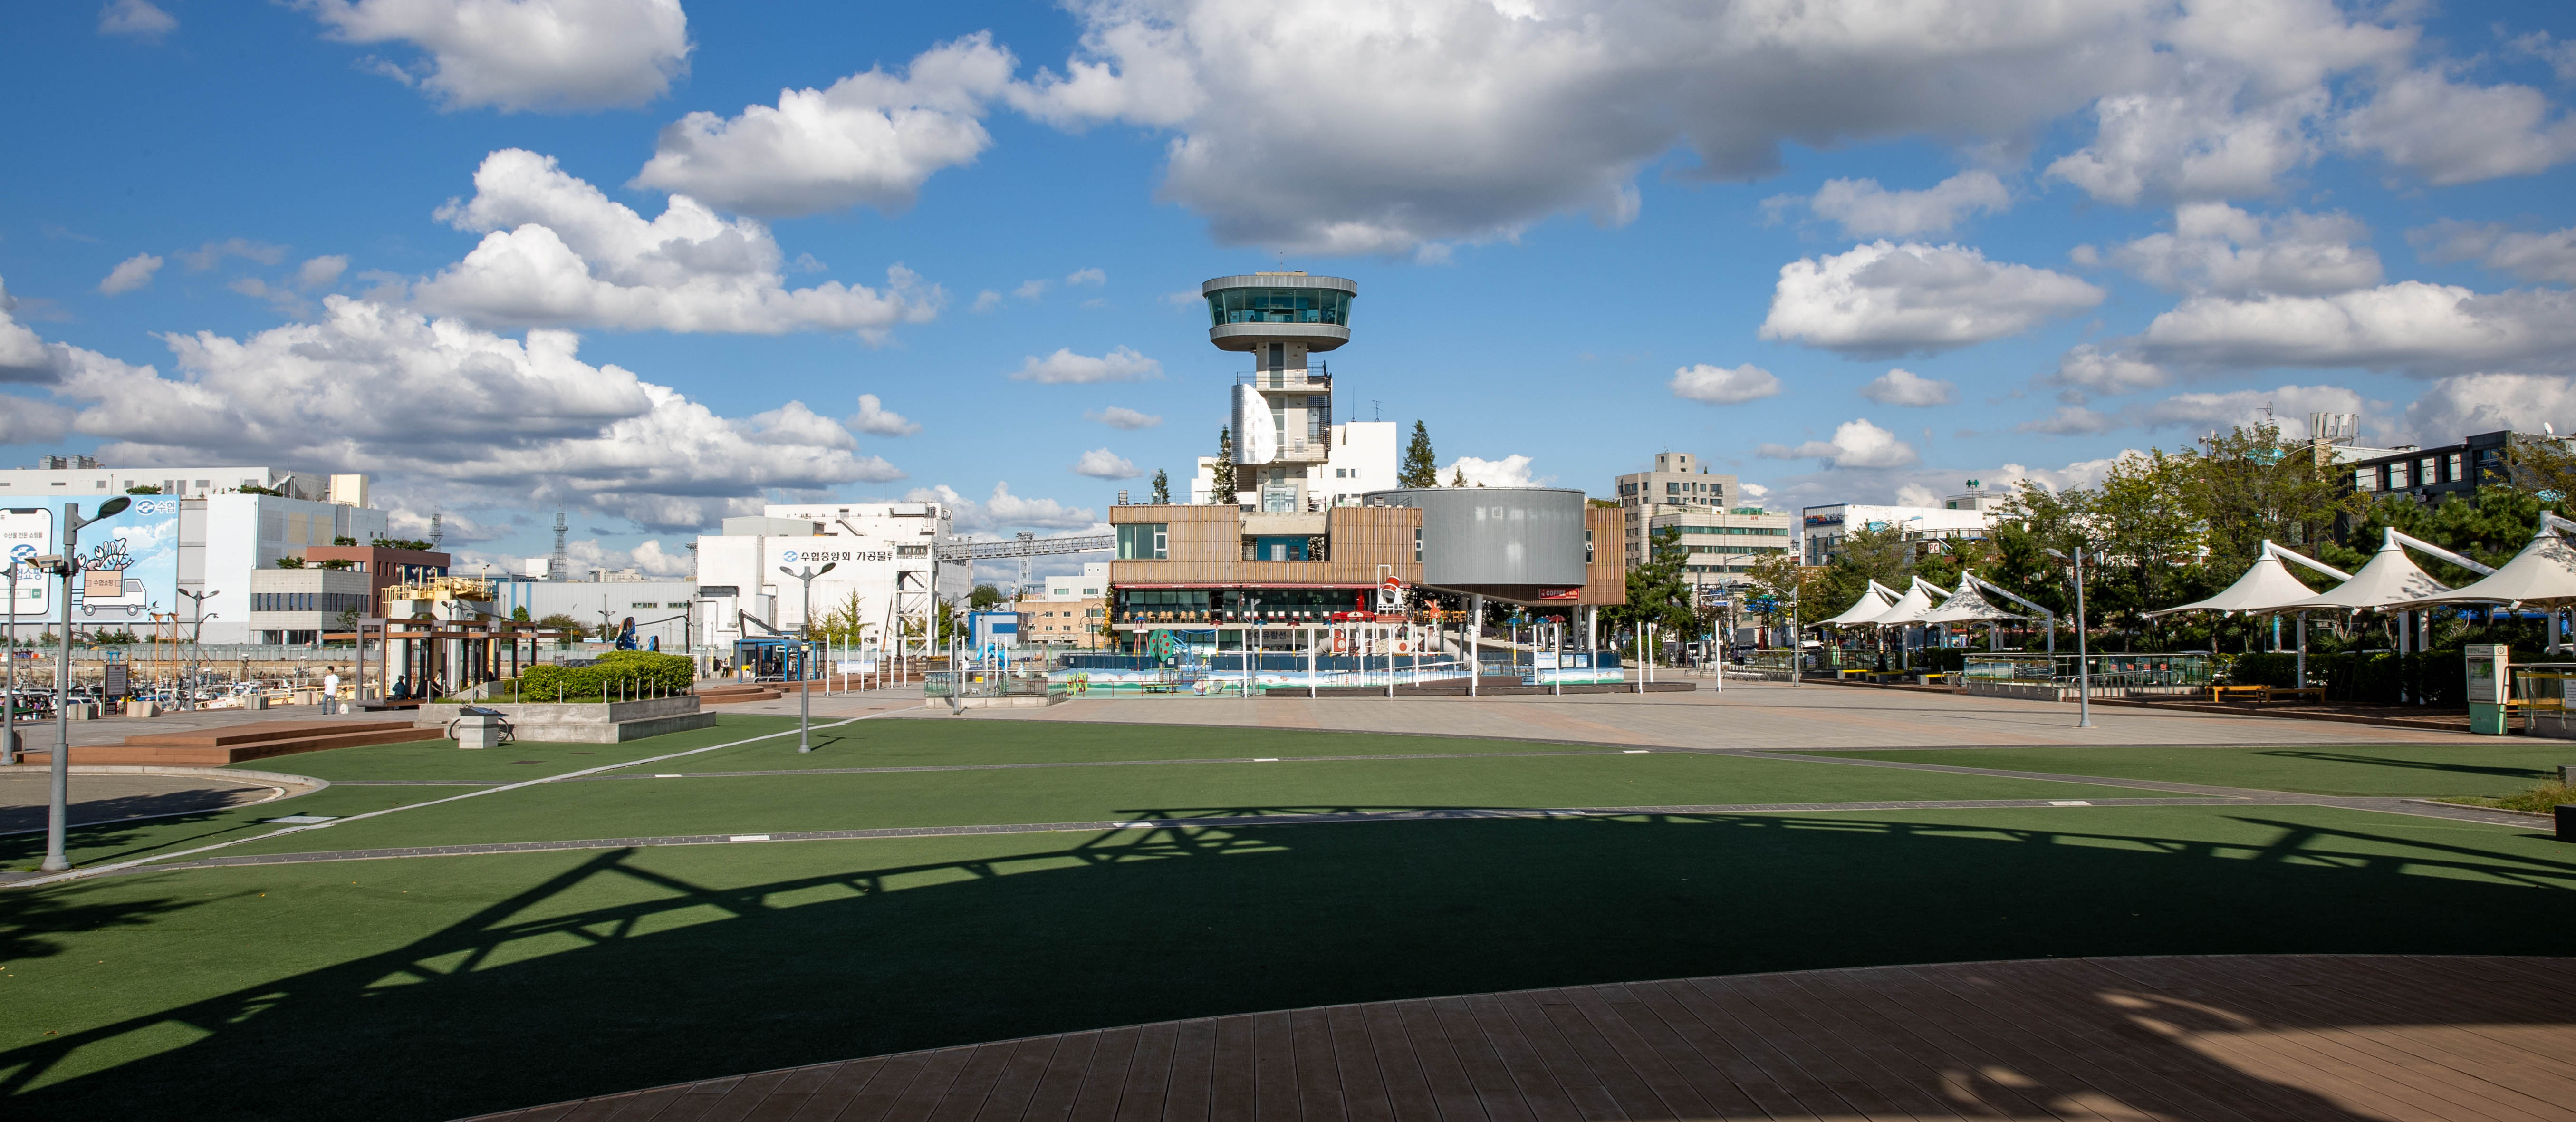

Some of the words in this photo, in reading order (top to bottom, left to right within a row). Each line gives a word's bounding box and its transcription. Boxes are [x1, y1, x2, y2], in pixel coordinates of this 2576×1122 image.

[156, 500, 176, 513] 수협
[1929, 544, 1938, 552] PC
[800, 551, 850, 561] 수협중앙회
[7, 568, 42, 580] 협쇼핑
